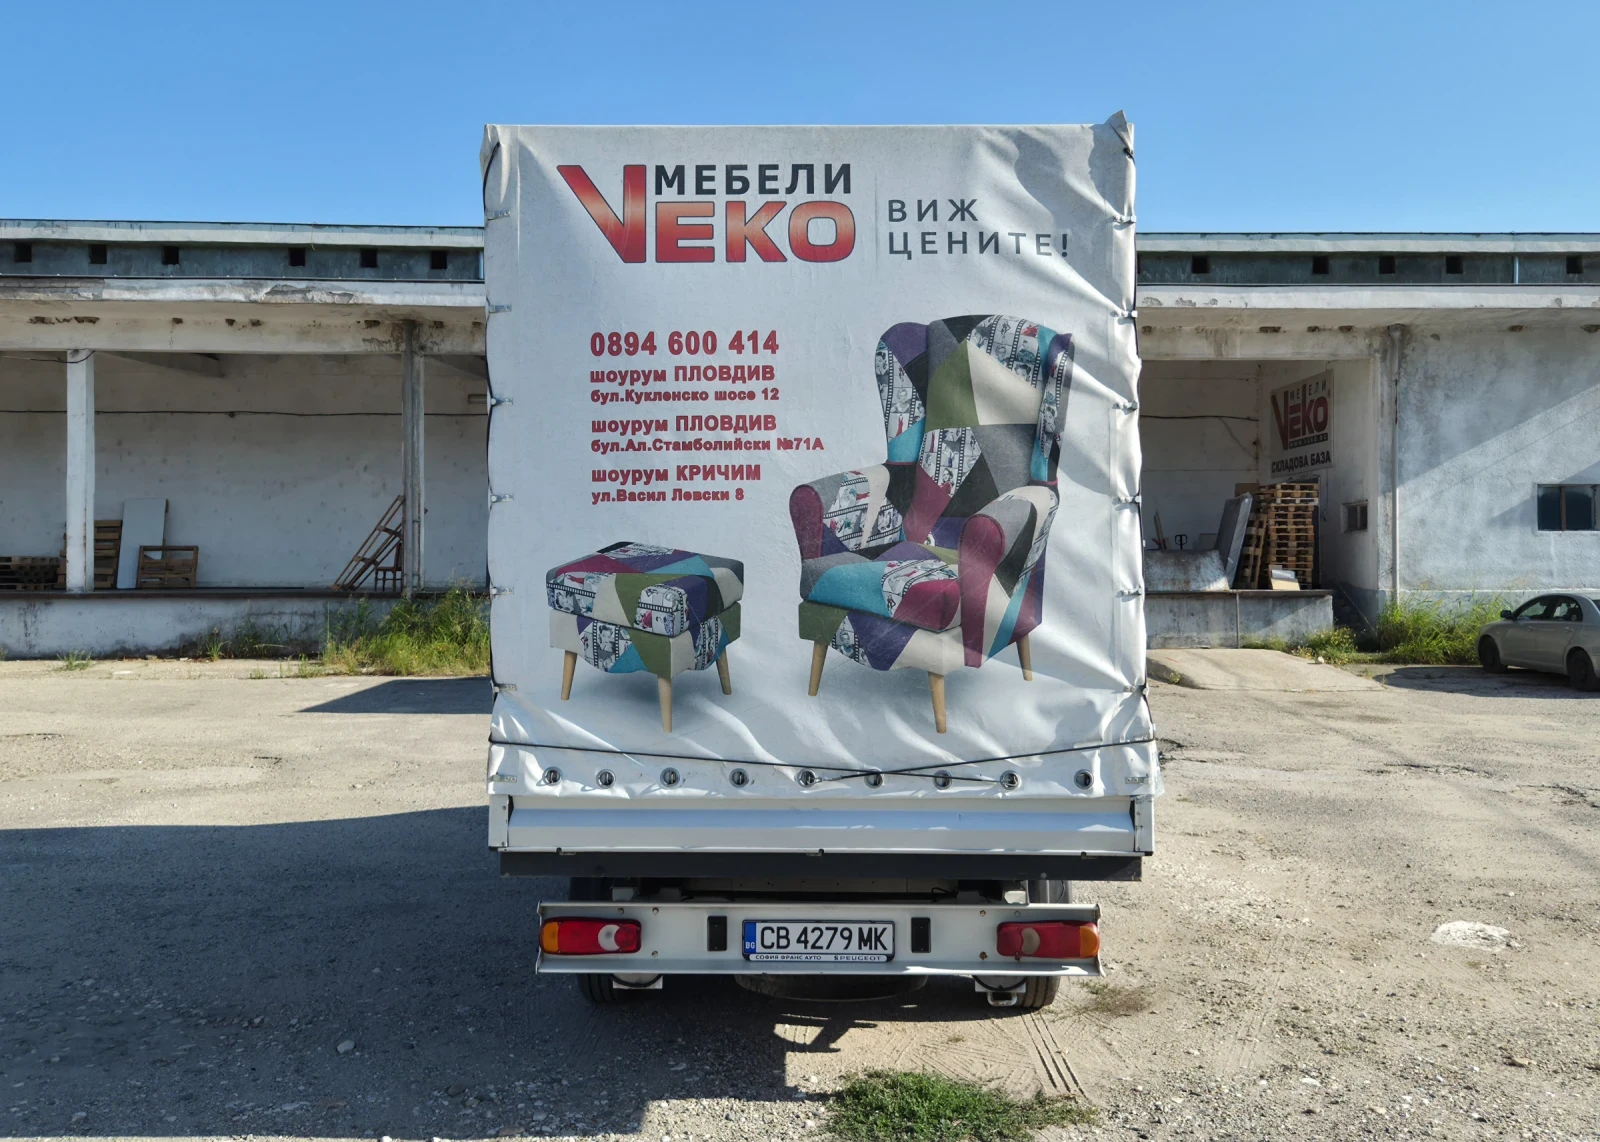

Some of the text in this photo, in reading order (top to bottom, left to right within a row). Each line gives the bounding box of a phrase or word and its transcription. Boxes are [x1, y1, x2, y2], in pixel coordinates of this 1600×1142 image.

[654, 163, 852, 195] МЕБЕЛИ
[556, 164, 856, 264] VEKO
[888, 198, 979, 222] ВИЖ
[888, 230, 1070, 261] ЦЕНИТЕ!
[590, 329, 780, 357] 0894 600 414
[590, 365, 776, 387] шоурум ПЛОВДИВ
[590, 387, 780, 406] бул.Кукленско шосе 12
[591, 414, 777, 437] шоурум ПЛОВДИВ
[590, 437, 772, 455] бул.Ал.Стамболийски
[1271, 450, 1332, 473] СКЛАДОВА БАЗА
[591, 464, 762, 486] шоурум КРИЧИМ
[591, 487, 745, 505] ул.Васил Левски 8
[745, 941, 756, 949] BG
[760, 926, 888, 951] CB 4279 MK
